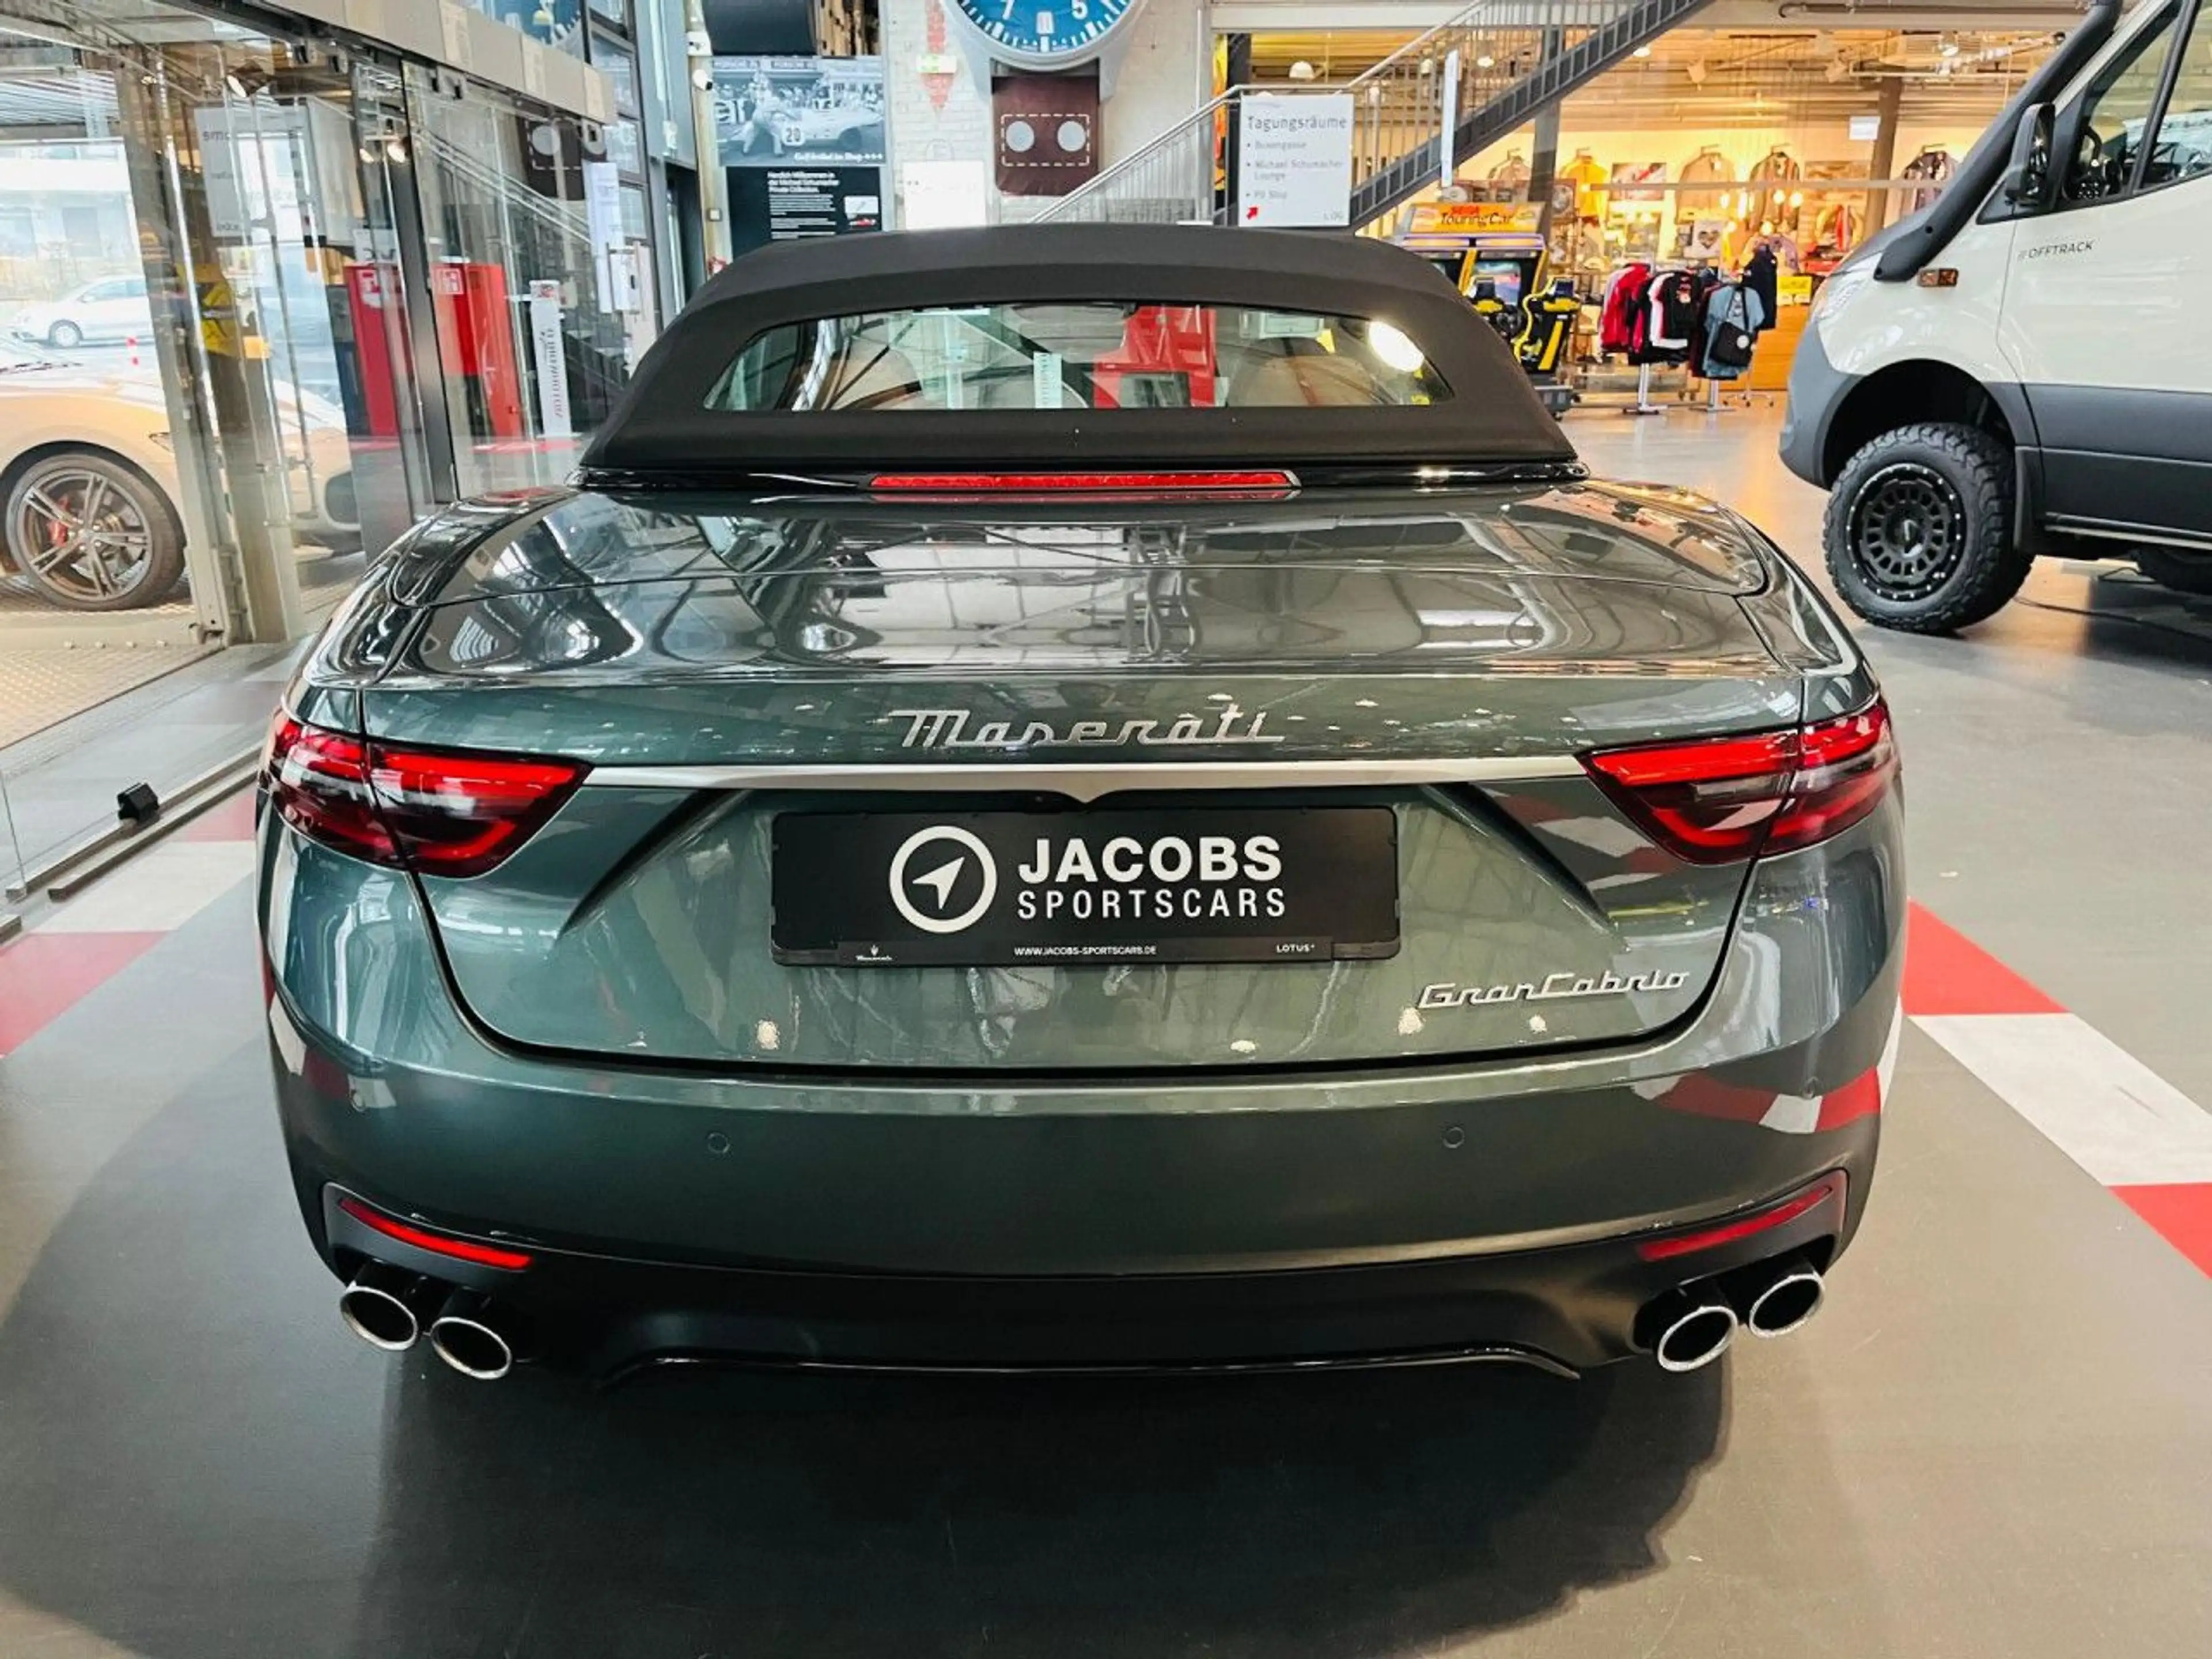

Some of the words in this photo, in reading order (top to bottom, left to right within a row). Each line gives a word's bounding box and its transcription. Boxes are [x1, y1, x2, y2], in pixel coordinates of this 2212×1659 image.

[1248, 115, 1347, 132] Tagungsräume
[786, 127, 801, 143] 20
[1255, 160, 1287, 168] Michael
[1291, 160, 1342, 168] Schumacher
[888, 704, 1285, 748] Maserati
[1018, 836, 1283, 883] JACOBS
[1017, 887, 1286, 919] SPORTSCARS
[1014, 946, 1156, 956] WWW.JACOBS-SPORTSCARS.DE
[1276, 943, 1310, 953] LOTUS
[1417, 970, 1690, 1009] GranCabrio
